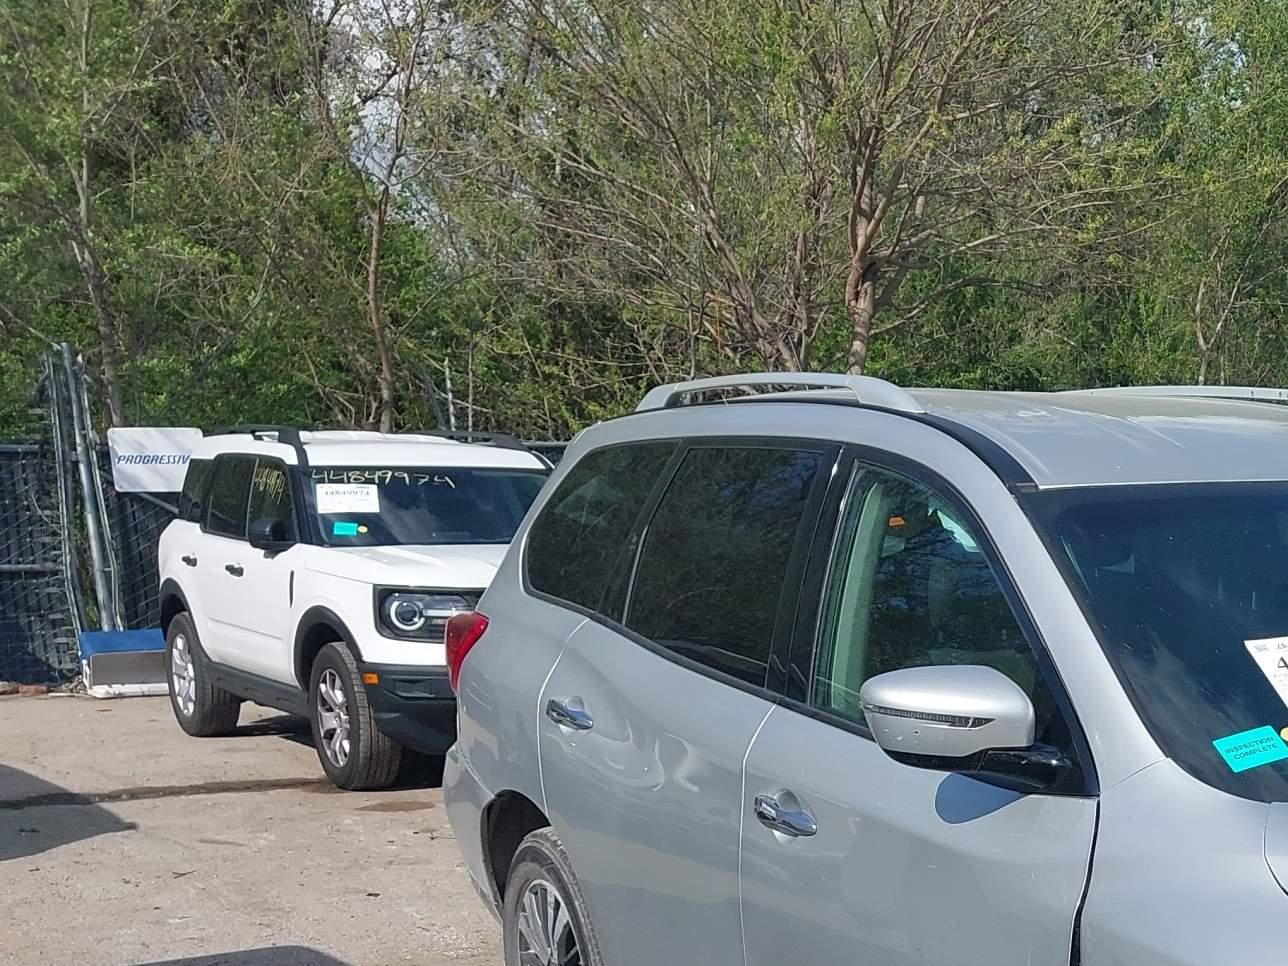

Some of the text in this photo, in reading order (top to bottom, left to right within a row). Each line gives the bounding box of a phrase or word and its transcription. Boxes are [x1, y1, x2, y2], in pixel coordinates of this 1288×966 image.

[116, 454, 191, 465] PROGRESSIV
[311, 469, 456, 489] 44849974
[1224, 735, 1275, 754] INSPECTION
[1233, 743, 1280, 760] COMPLETE
